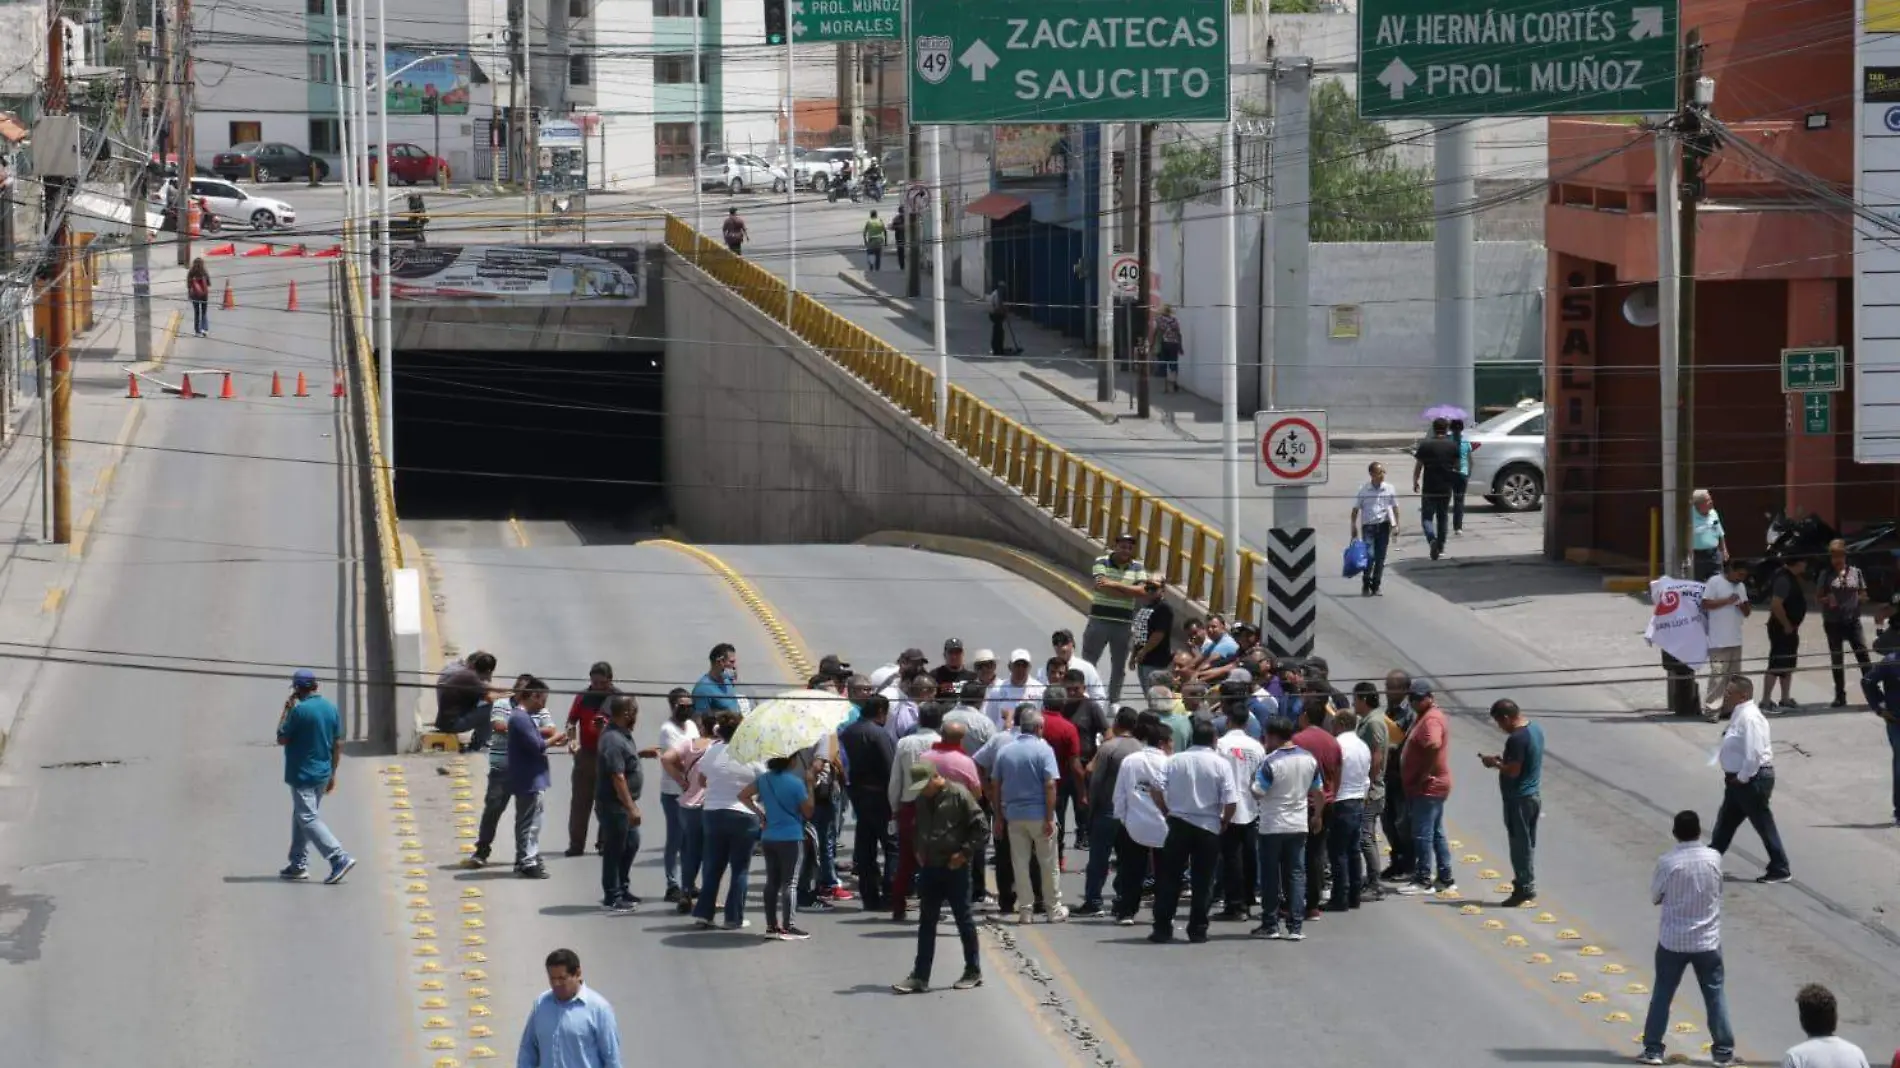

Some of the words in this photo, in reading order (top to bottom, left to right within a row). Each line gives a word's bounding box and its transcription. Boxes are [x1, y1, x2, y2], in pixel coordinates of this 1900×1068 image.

[811, 1, 851, 15] PROL.
[820, 17, 894, 35] MORALES
[1006, 17, 1219, 49] ZACATECAS
[1376, 15, 1409, 45] AV.
[1416, 9, 1516, 45] HERNÁN
[1522, 7, 1616, 43] CORTÉS
[922, 52, 947, 72] 49
[1427, 63, 1521, 95] PROL.
[1531, 55, 1645, 92] MUÑOZ
[1015, 67, 1210, 100] SAUCITO
[1118, 265, 1140, 281] 40
